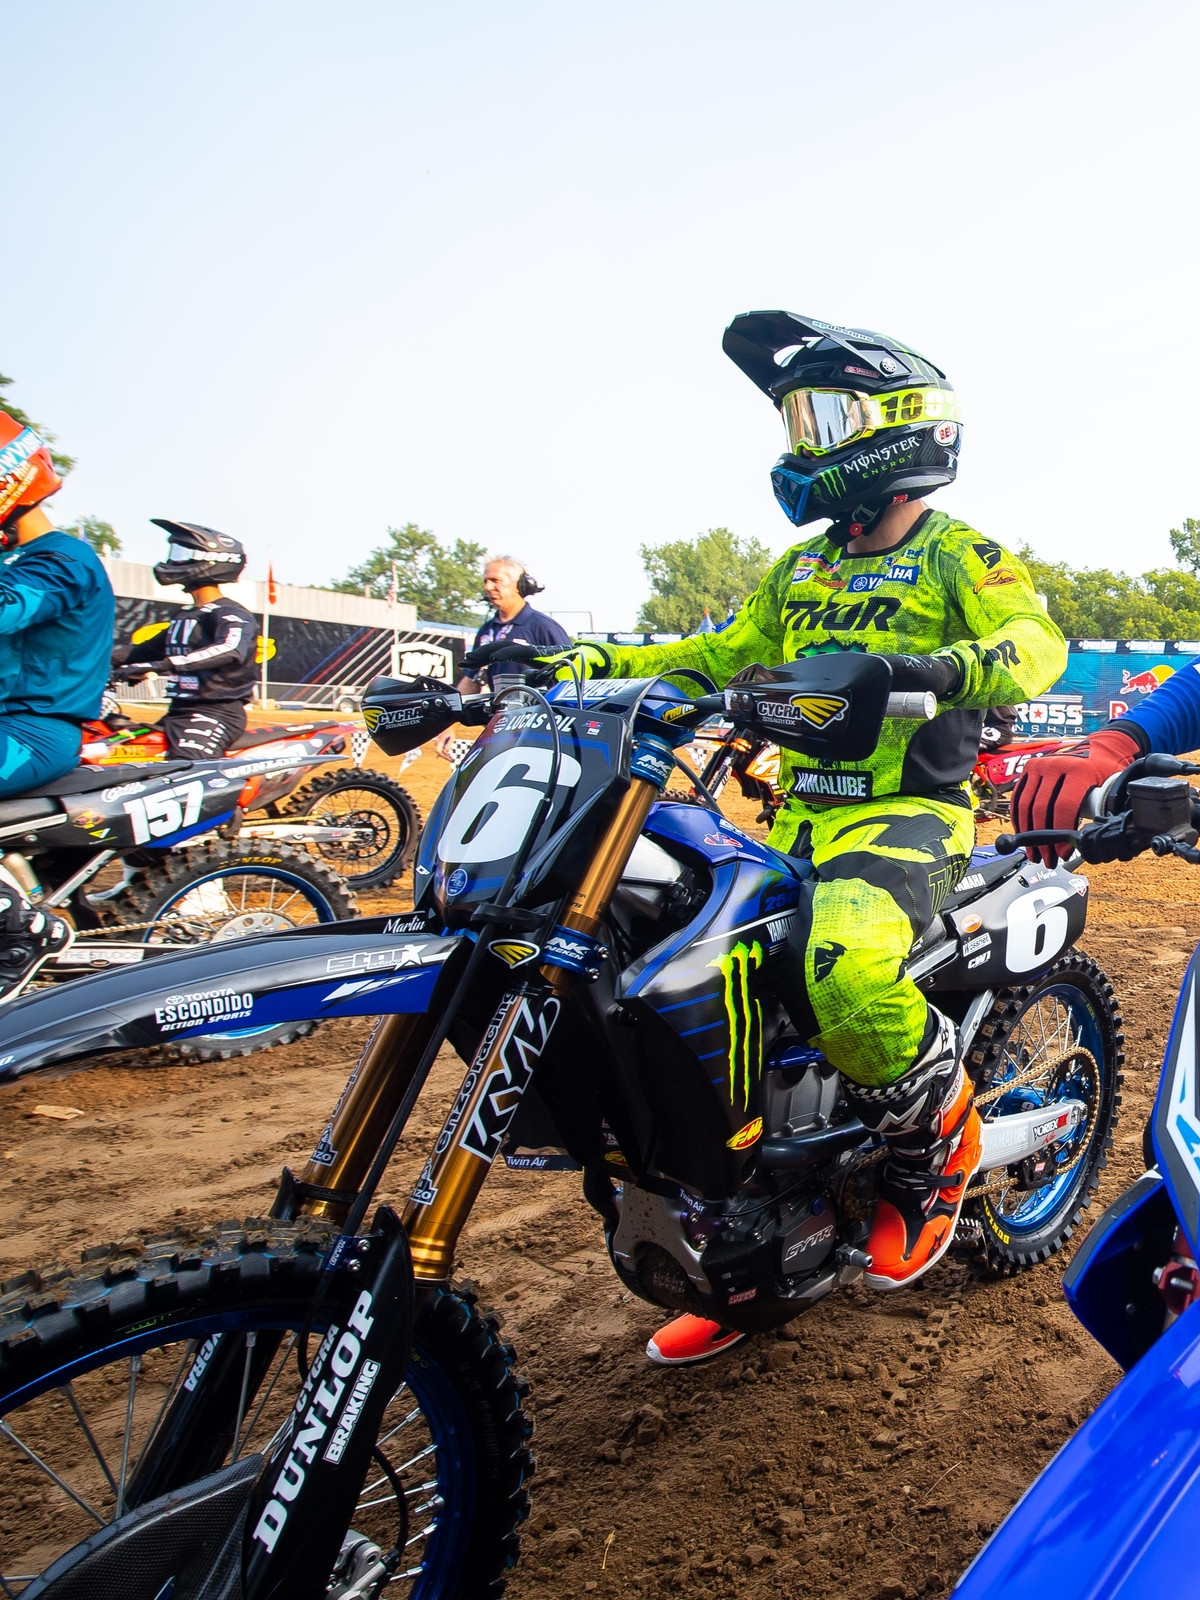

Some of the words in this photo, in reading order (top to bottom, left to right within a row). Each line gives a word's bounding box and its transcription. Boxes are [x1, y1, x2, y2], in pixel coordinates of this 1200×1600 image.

[844, 436, 921, 475] MONSTER
[863, 453, 914, 479] ENERGY
[868, 567, 914, 590] YAAHA
[400, 651, 446, 678] 100%
[378, 706, 423, 726] CYCRA
[757, 702, 802, 720] CYCRA
[1015, 704, 1084, 726] ROSS
[504, 713, 545, 733] LUCAS
[545, 715, 577, 733] OIL
[1014, 724, 1083, 735] NSHIP
[636, 760, 670, 779] NEKEN
[795, 772, 868, 798] YAMALUBE
[123, 780, 204, 846] 157
[437, 746, 583, 863] 6
[382, 915, 426, 934] Martin
[1005, 886, 1070, 973] 6
[544, 943, 584, 961] NEKEN
[183, 988, 236, 1001] TOYOTA
[154, 992, 254, 1024] ESCONDIDO
[160, 1017, 204, 1032] ACTION
[207, 1009, 252, 1024] SPORTS
[1033, 1119, 1059, 1141] VORTEX
[506, 1156, 530, 1167] Twin
[531, 1157, 548, 1167] Air
[679, 1188, 695, 1208] Twin
[692, 1200, 706, 1214] Air
[295, 1323, 340, 1416] CYCRA
[251, 1289, 375, 1554] DUNLOP
[328, 1361, 380, 1461] BRAKING
